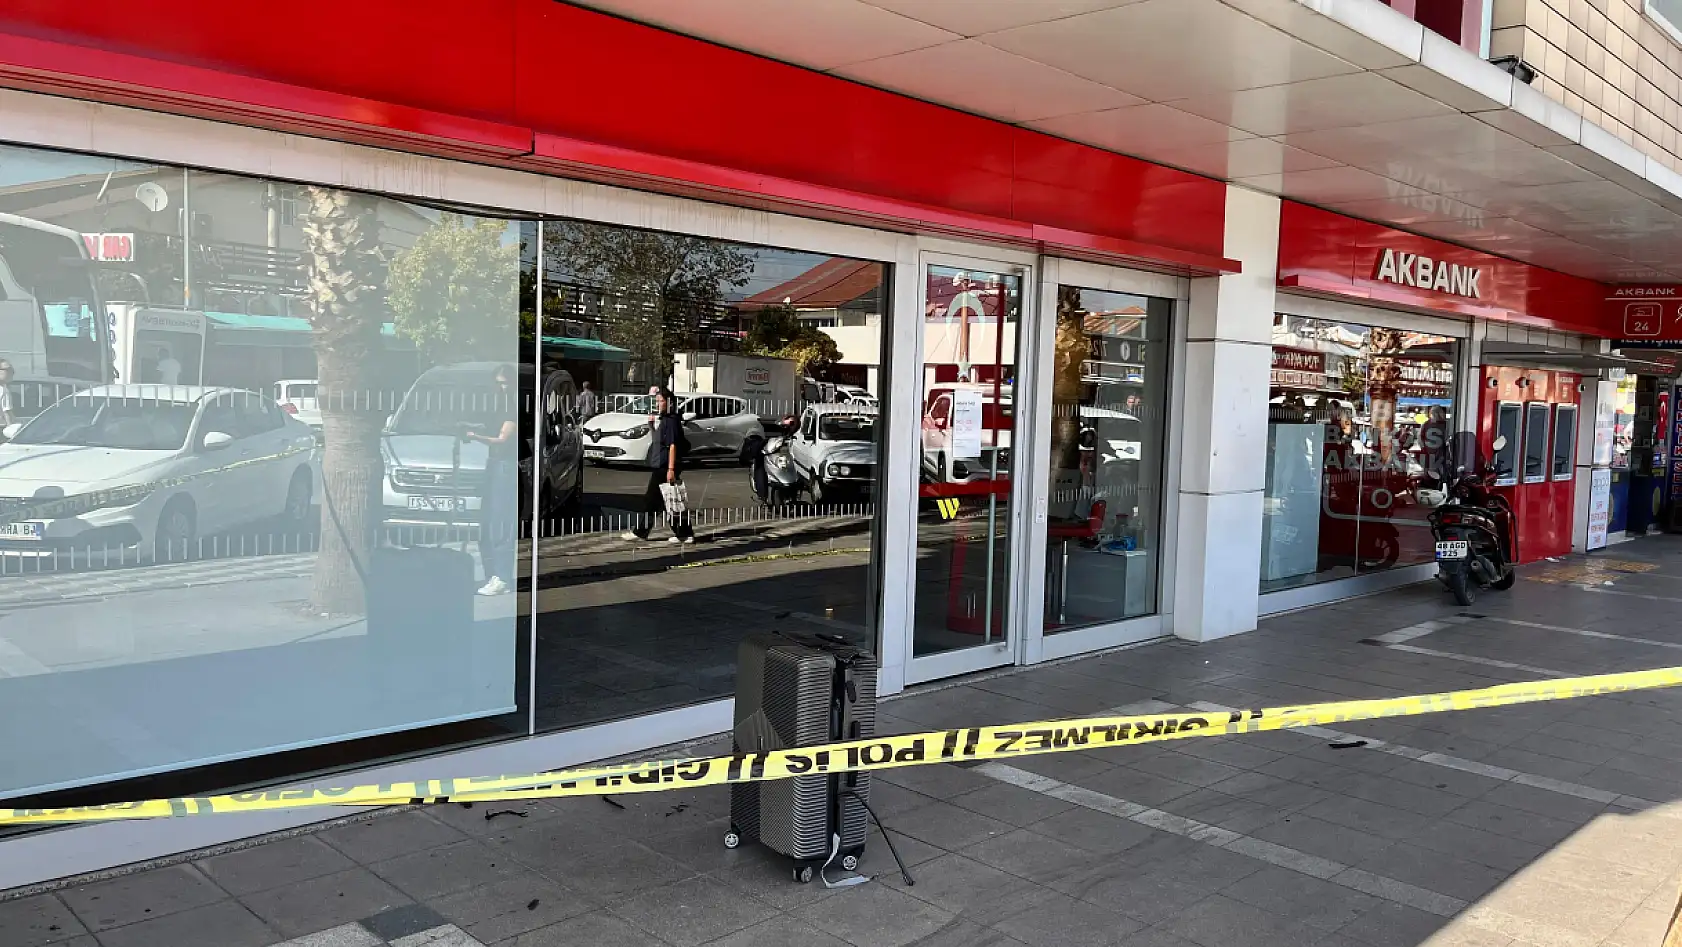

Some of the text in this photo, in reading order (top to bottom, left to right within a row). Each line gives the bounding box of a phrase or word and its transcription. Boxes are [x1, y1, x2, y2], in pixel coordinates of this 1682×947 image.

[1377, 248, 1481, 299] AKBANK
[1615, 288, 1676, 296] AKBANK
[1634, 321, 1650, 332] 24
[785, 739, 925, 774] POLİS
